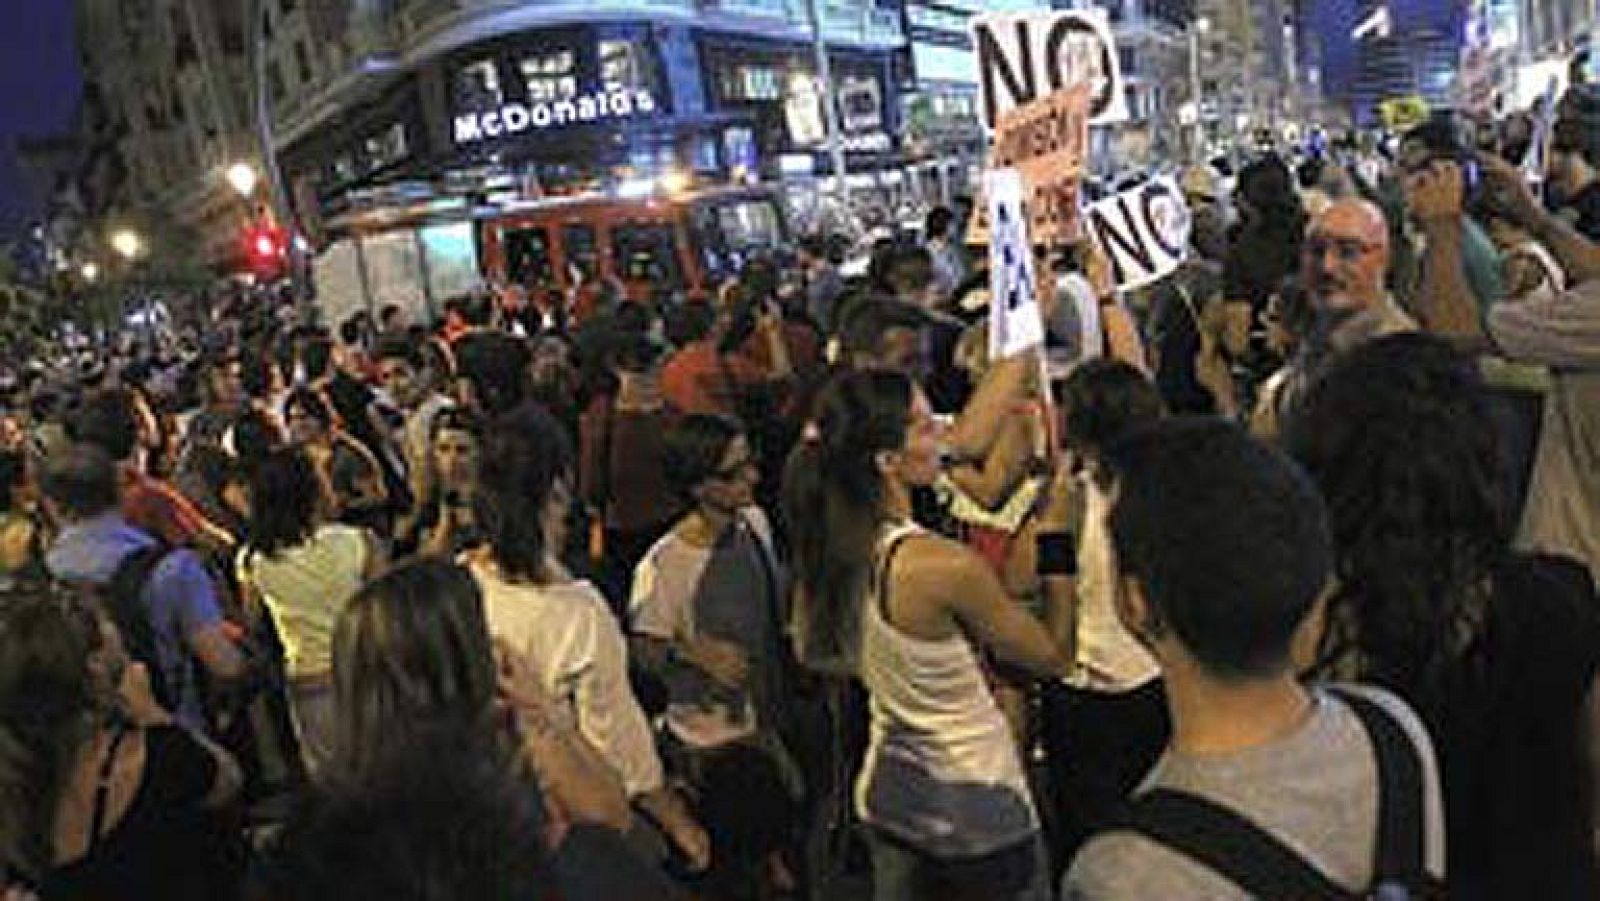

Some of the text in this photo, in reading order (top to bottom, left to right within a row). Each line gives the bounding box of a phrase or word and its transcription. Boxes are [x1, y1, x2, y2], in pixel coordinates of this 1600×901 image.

[454, 83, 655, 143] McDonald's
[975, 16, 1114, 130] NO
[1088, 184, 1190, 285] NO
